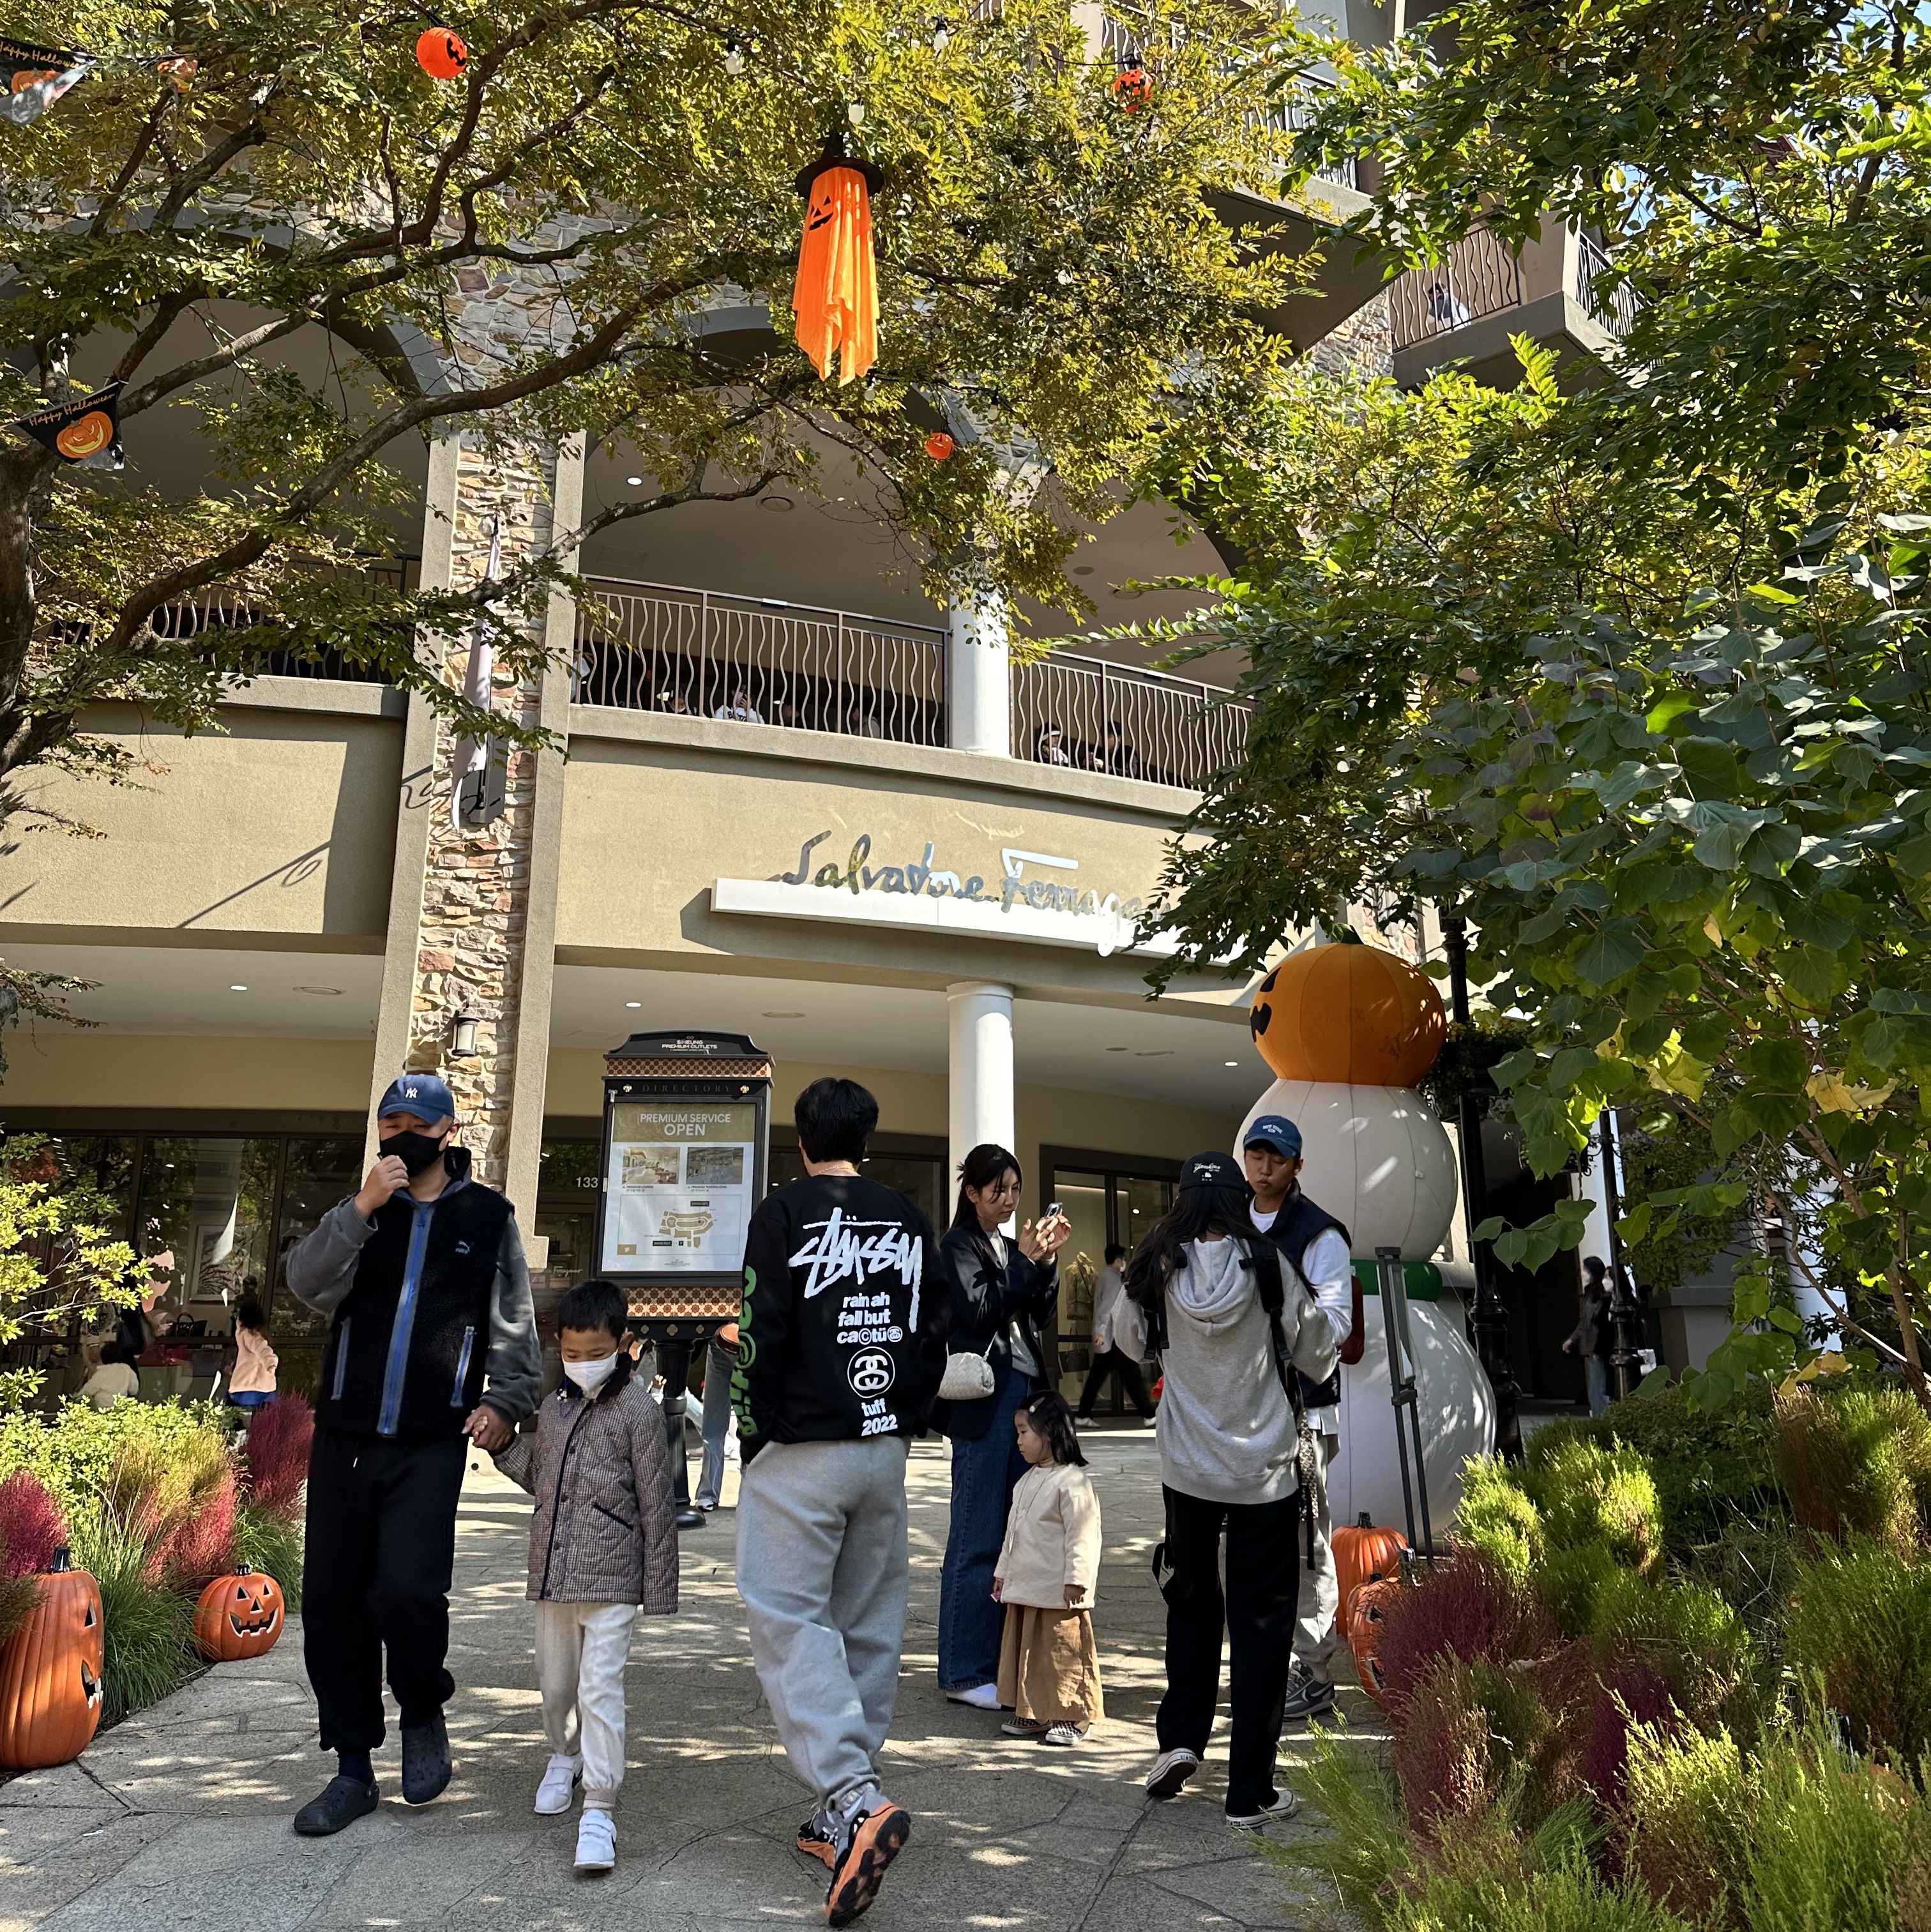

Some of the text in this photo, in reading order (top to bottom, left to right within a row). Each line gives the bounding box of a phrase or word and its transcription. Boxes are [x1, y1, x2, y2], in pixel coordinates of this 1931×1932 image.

[29, 393, 115, 426] Happy Halloween
[779, 830, 1172, 957] Salvatore Ferraga
[405, 1087, 418, 1099] NY
[640, 1113, 731, 1123] PREMIUM SERVICE
[663, 1123, 706, 1136] OPEN
[575, 1176, 598, 1188] 133
[843, 1291, 890, 1309] rain ah
[838, 1308, 891, 1327] fall but
[861, 1397, 886, 1417] tuff
[861, 1413, 898, 1436] 2022
